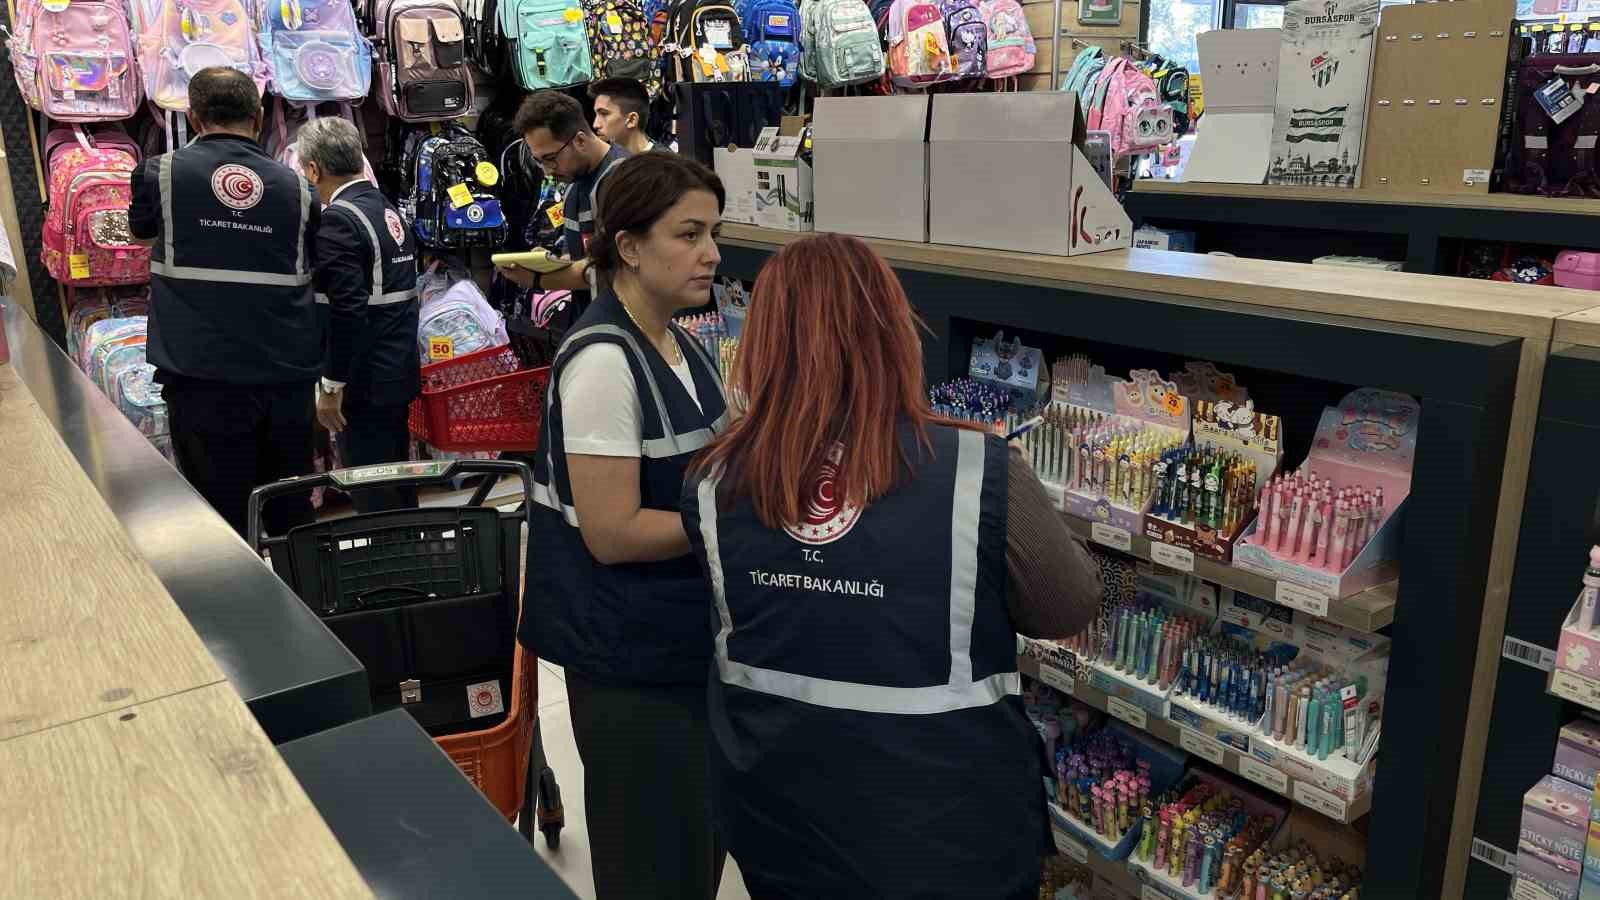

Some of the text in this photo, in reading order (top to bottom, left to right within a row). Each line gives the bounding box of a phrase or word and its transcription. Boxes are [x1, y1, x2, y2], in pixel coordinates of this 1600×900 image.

[1304, 14, 1355, 25] BURSASPOR
[199, 218, 273, 234] TİCARET BAKANLIĞI
[432, 343, 450, 354] 50
[801, 549, 824, 563] T.C.
[749, 570, 884, 598] TİCARET BAKANLIĞI
[1553, 762, 1587, 783] STICKY
[1519, 828, 1552, 850] STICKY
[1555, 842, 1582, 860] NOTE
